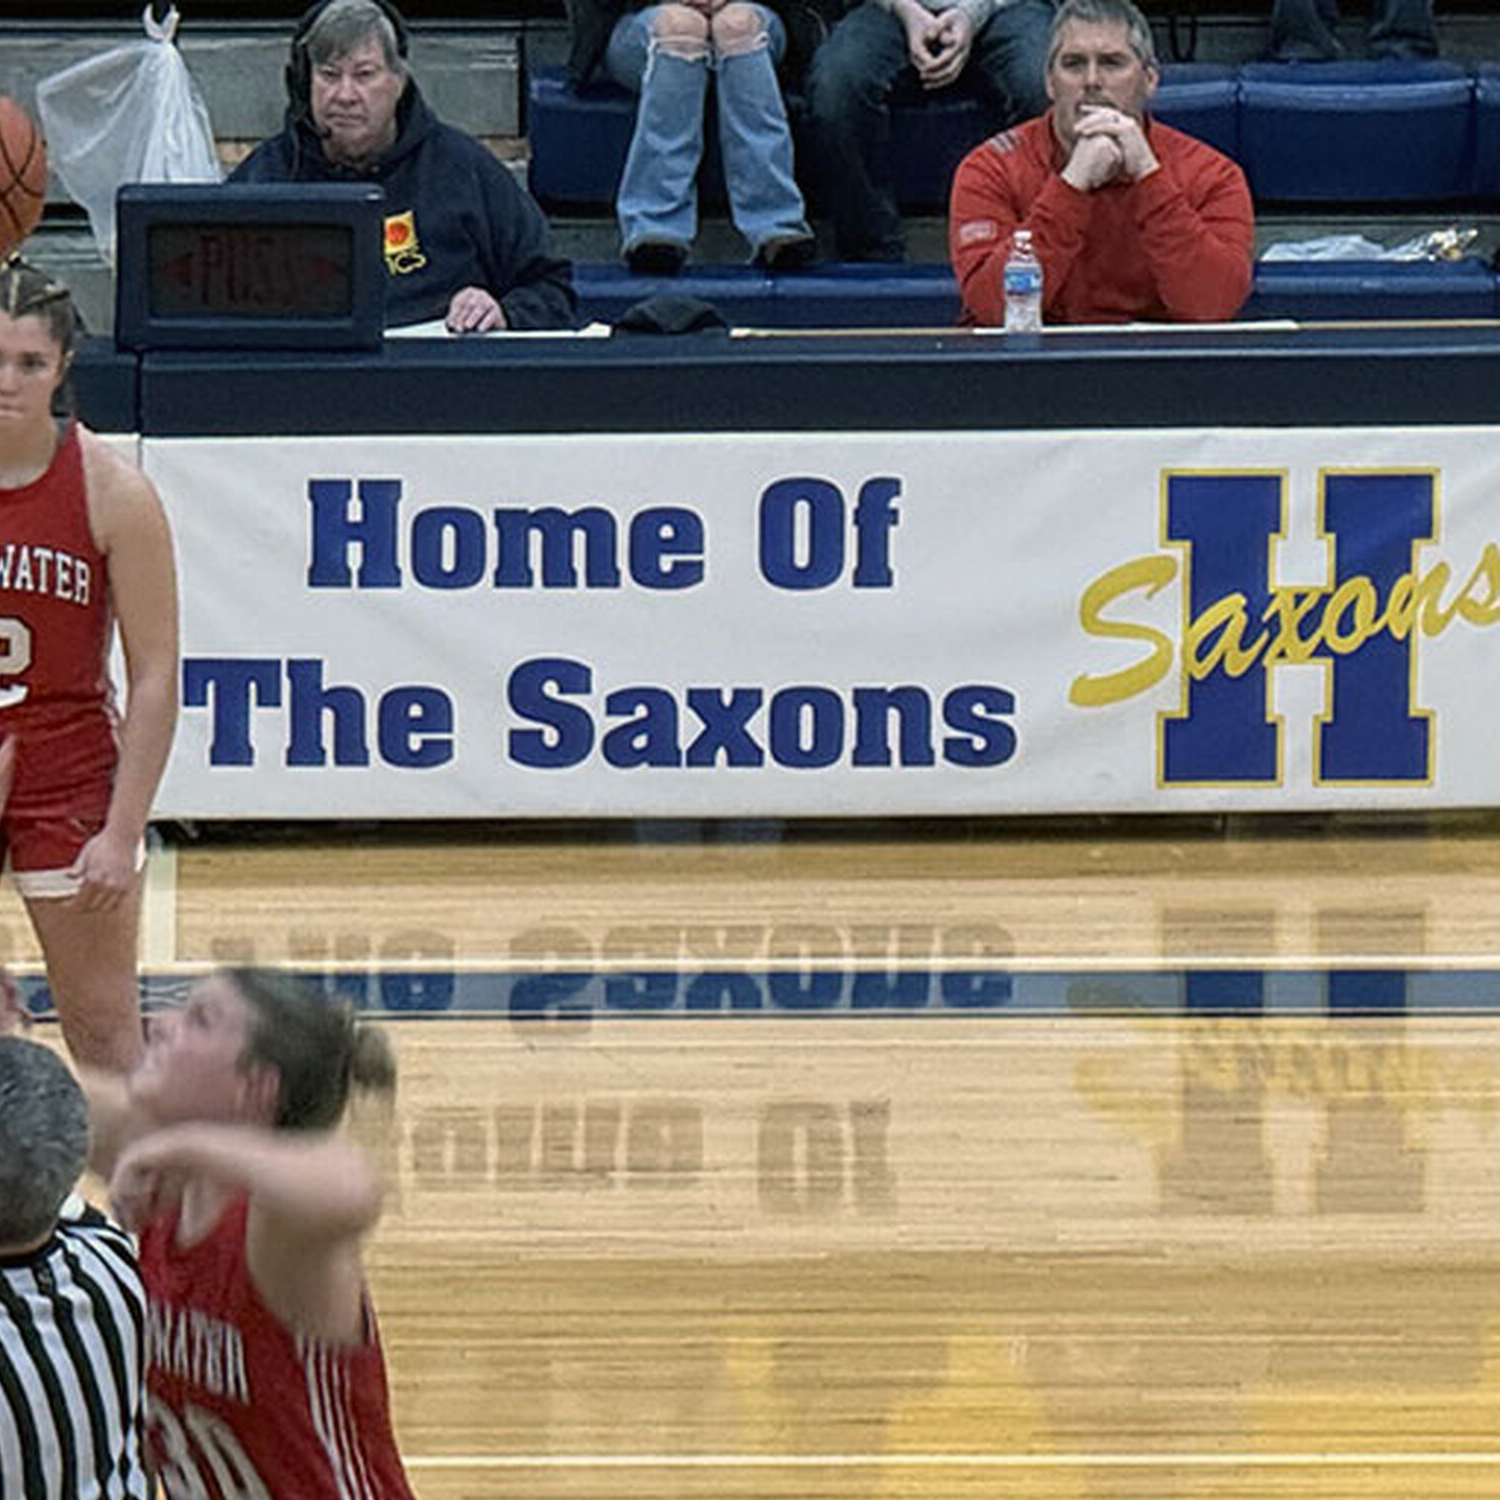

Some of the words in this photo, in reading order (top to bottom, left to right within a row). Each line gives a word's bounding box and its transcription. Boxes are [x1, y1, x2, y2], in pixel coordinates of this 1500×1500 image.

[307, 477, 706, 590] Home
[757, 476, 902, 590] Of
[1068, 542, 1500, 708] Saxons
[1155, 467, 1441, 790] H
[182, 658, 455, 769] The
[506, 656, 1018, 770] Saxons
